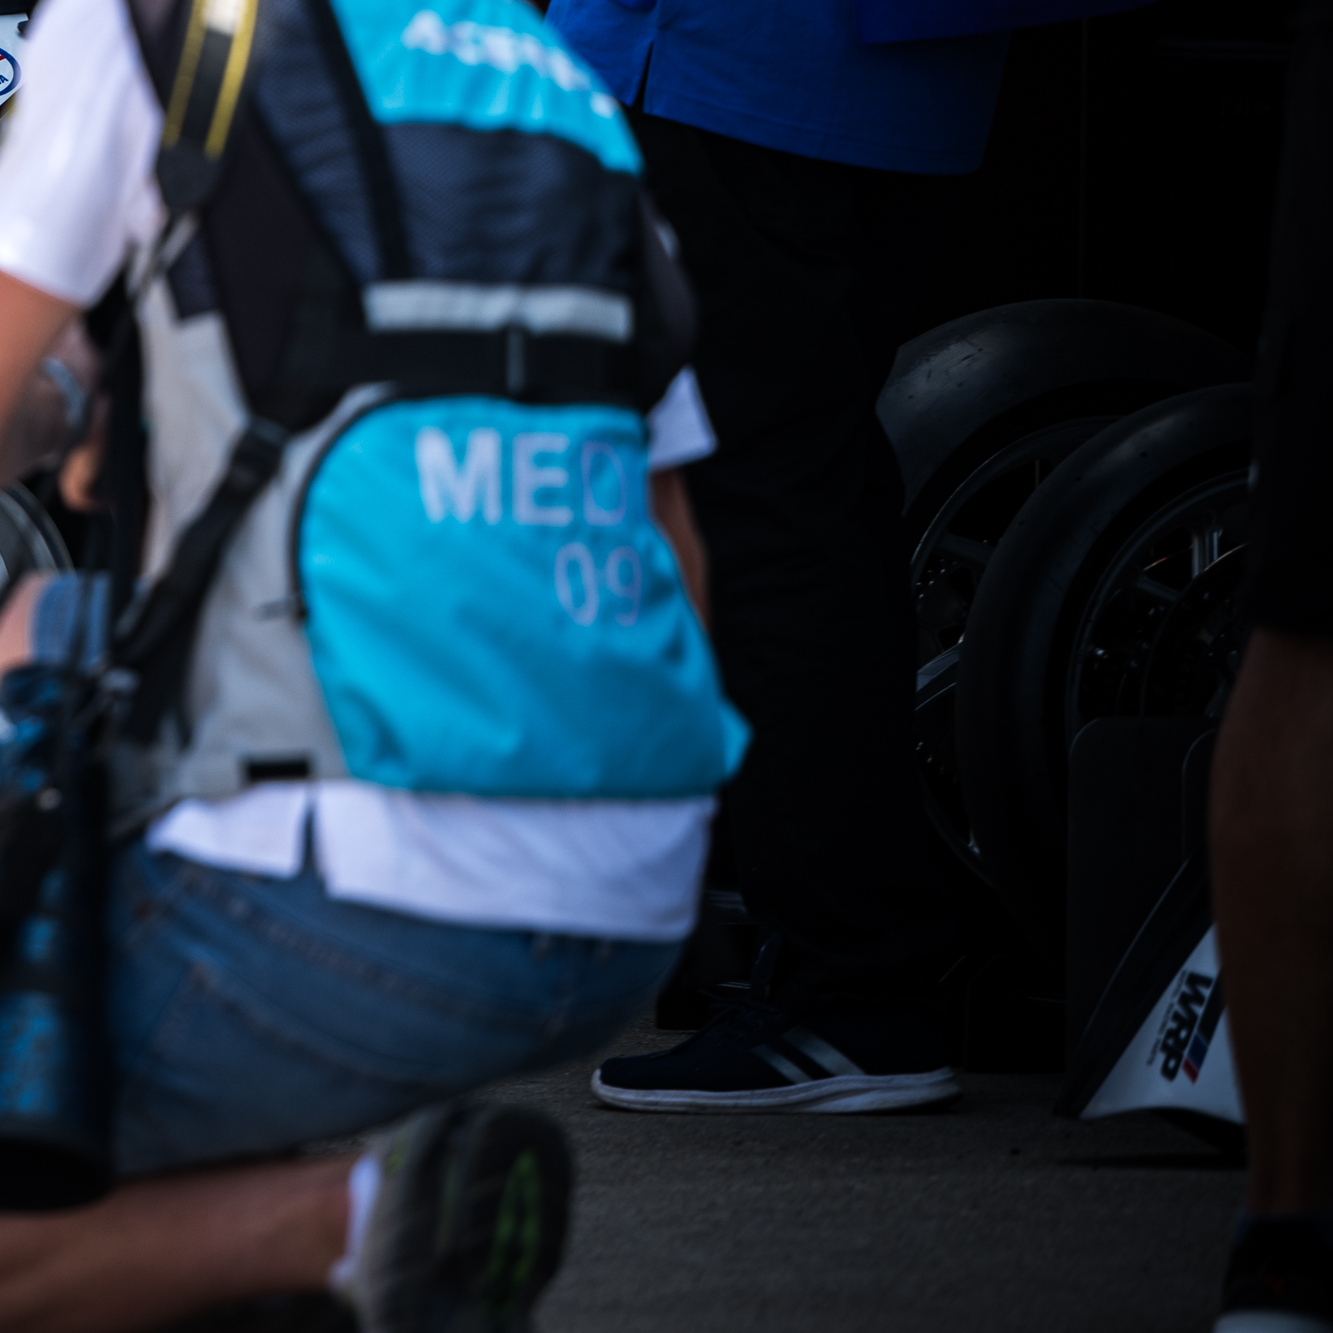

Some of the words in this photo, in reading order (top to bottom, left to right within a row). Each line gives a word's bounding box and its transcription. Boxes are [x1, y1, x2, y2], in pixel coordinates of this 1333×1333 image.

[415, 424, 631, 528] MED
[553, 539, 644, 628] 09
[1160, 970, 1215, 1083] WRP
